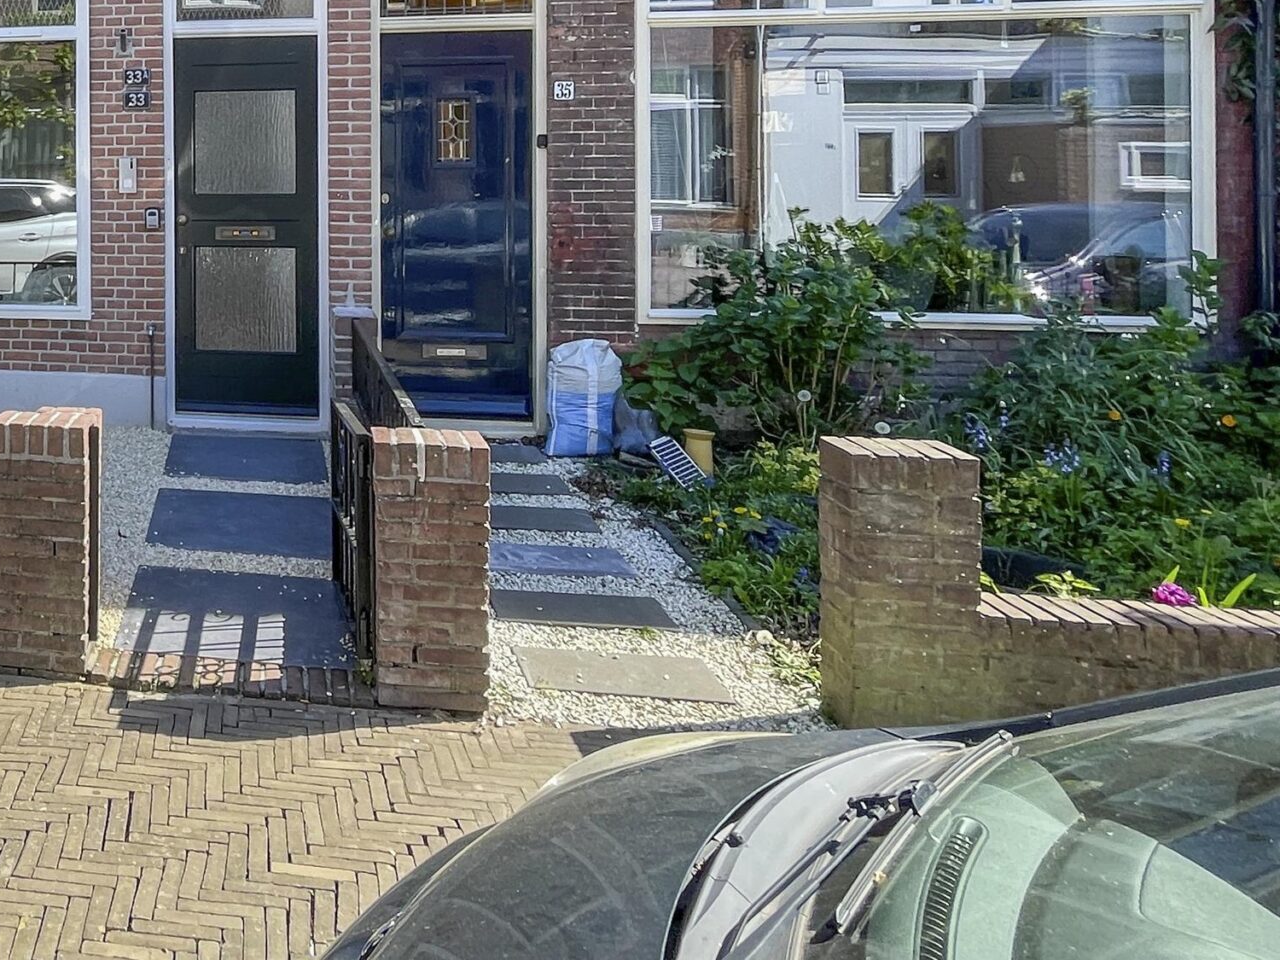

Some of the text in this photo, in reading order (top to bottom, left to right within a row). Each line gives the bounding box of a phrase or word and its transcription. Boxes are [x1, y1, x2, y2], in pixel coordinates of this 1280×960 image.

[126, 70, 148, 83] 33A
[556, 82, 572, 98] 35
[128, 93, 145, 106] 33
